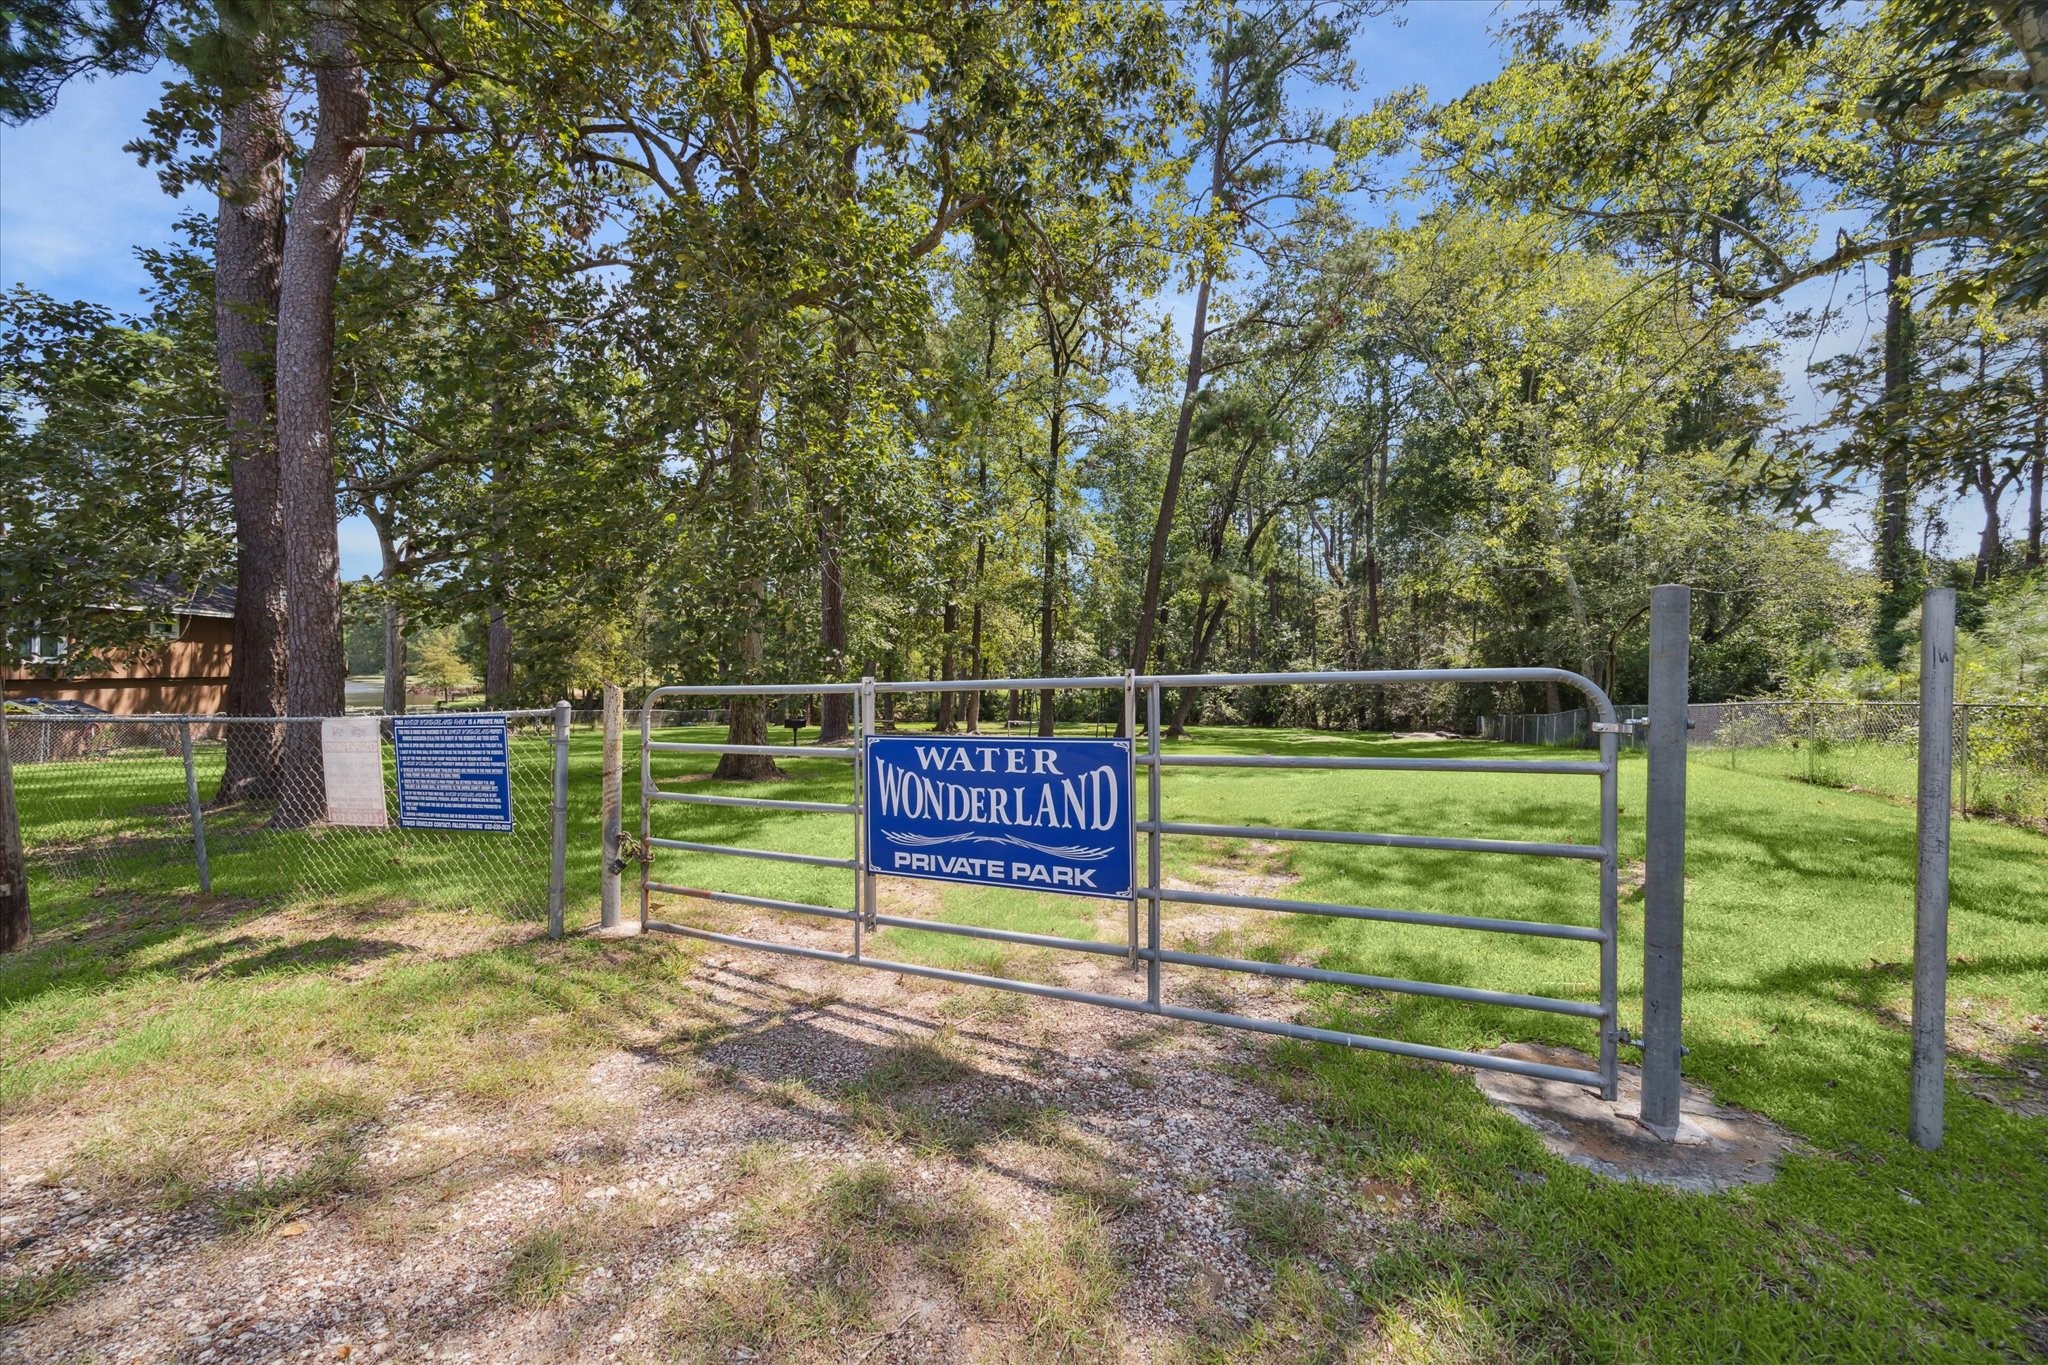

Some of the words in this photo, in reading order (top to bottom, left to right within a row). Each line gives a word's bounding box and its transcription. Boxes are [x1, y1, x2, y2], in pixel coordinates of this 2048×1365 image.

[914, 746, 1064, 775] WATER
[876, 756, 1118, 831] WONDERLAND
[894, 852, 1005, 878] PRIVATE
[1011, 862, 1098, 888] PARK
